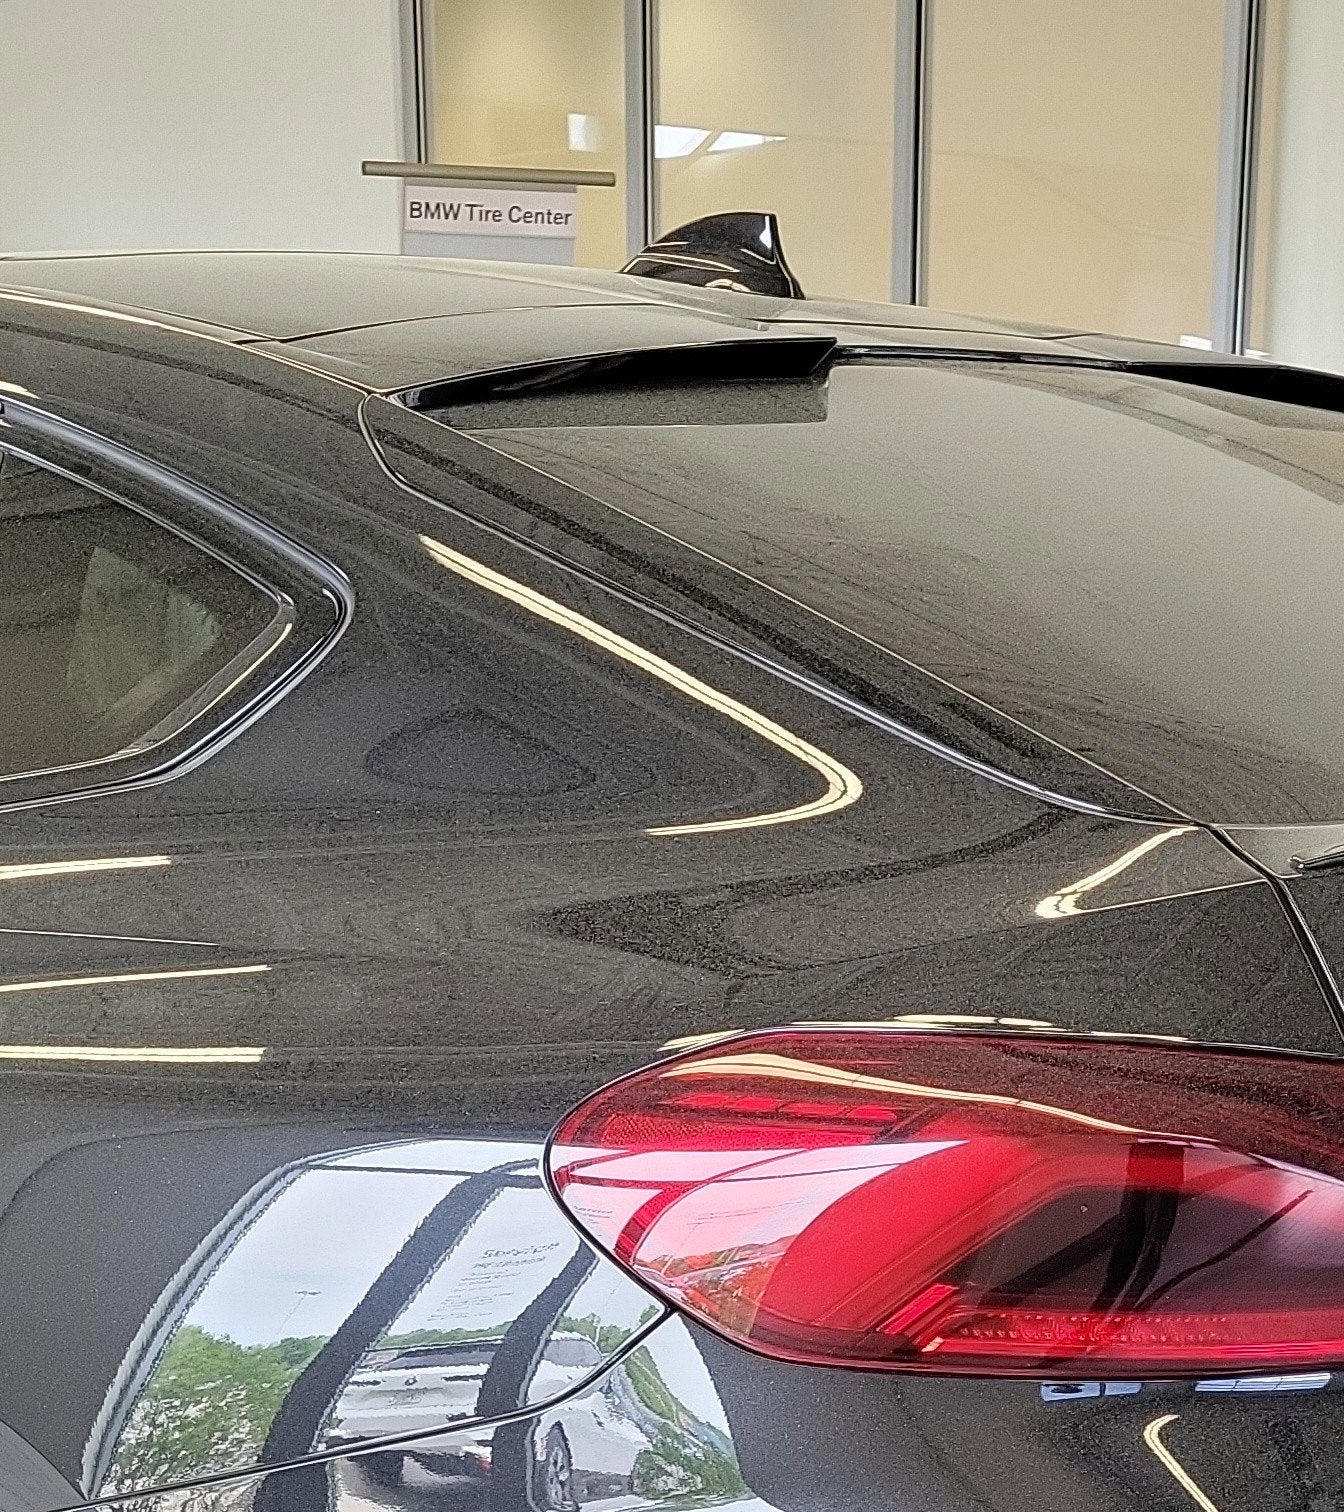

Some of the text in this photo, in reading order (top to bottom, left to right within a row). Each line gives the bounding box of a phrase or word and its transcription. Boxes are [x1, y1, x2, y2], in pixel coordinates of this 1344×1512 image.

[409, 201, 573, 226] BMW Tire Center
